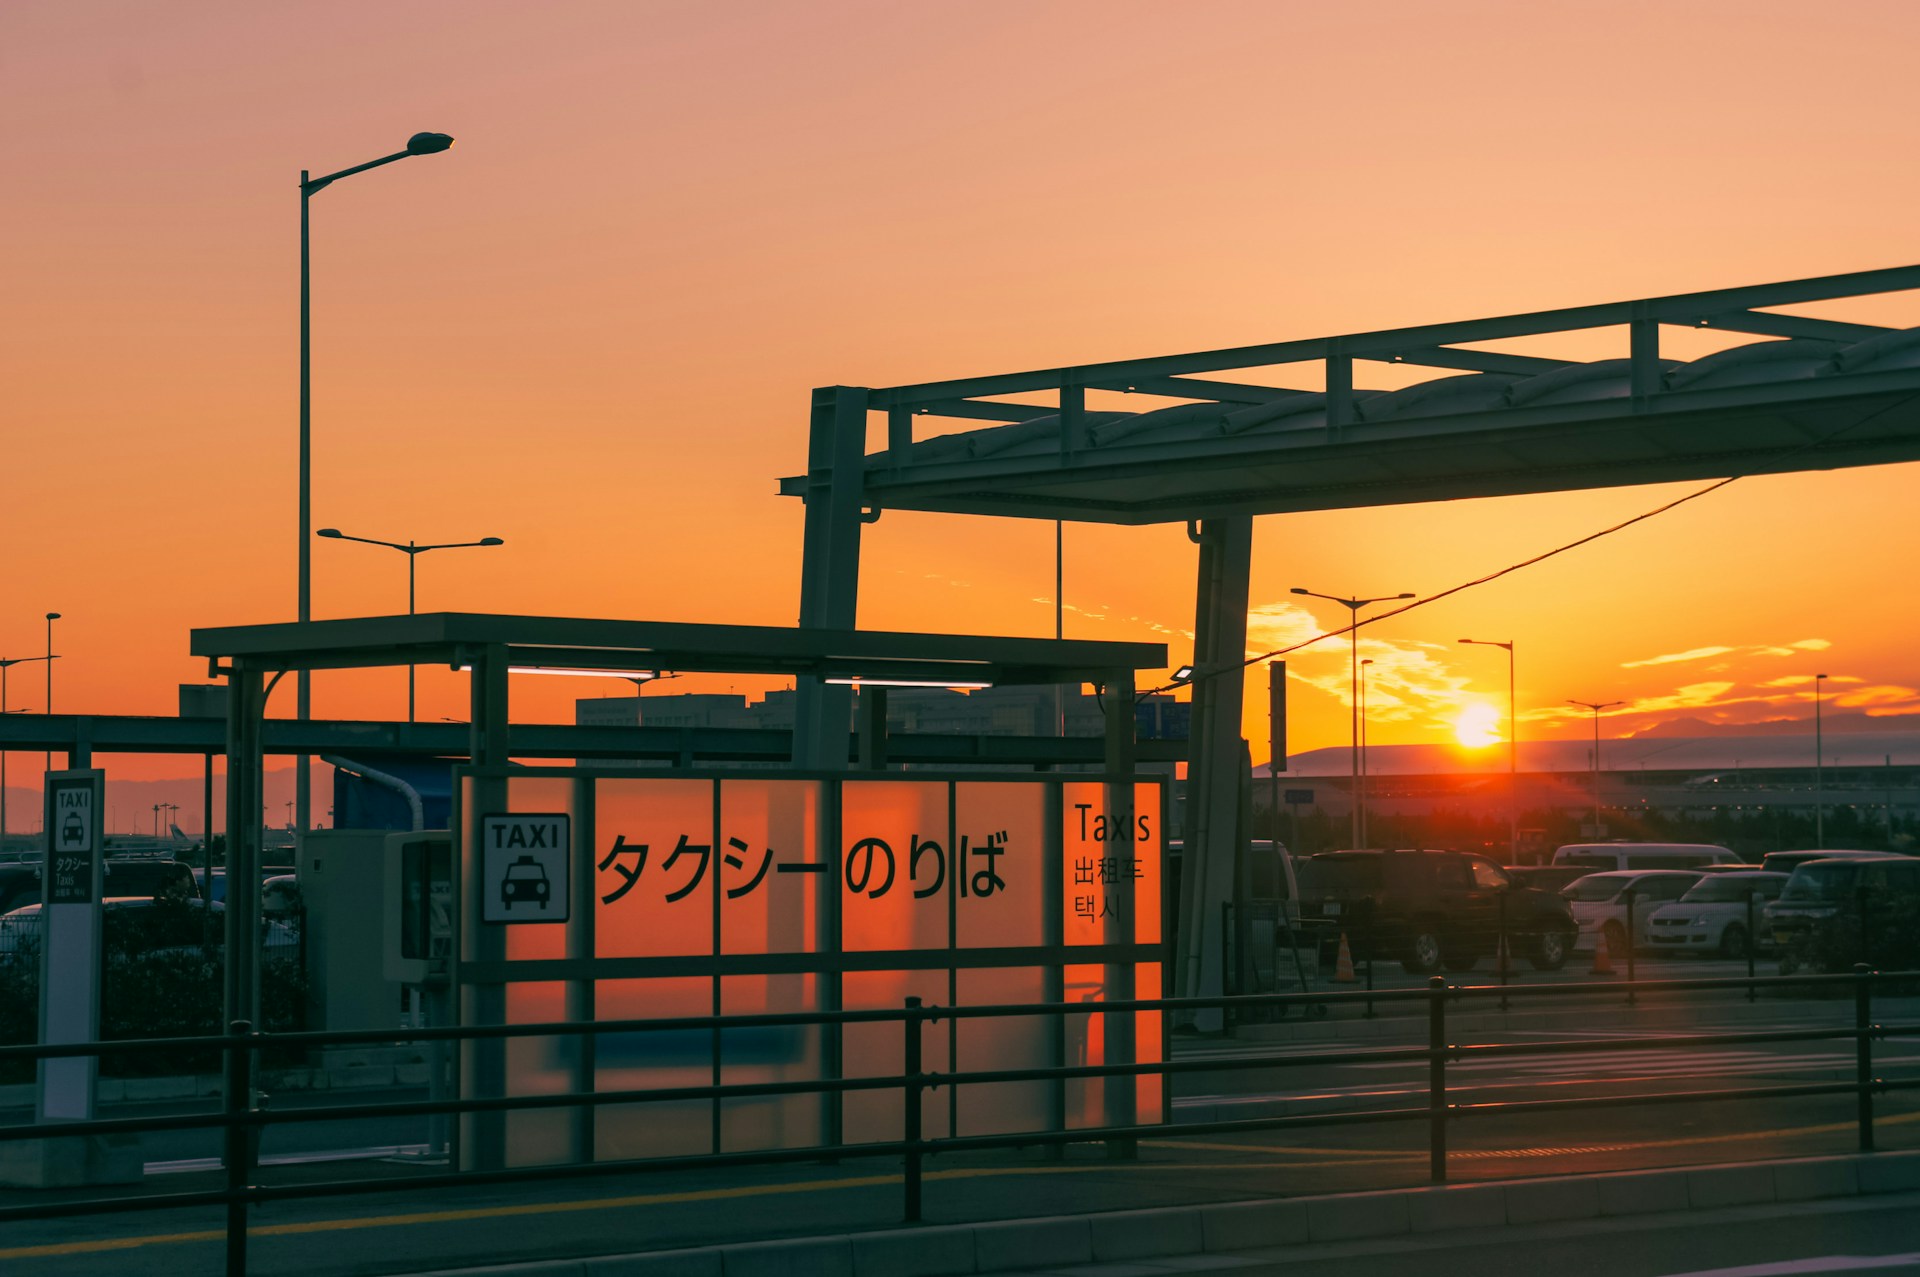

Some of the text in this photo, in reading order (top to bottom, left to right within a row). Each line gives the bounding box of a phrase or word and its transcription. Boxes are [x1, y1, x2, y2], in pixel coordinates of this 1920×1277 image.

[60, 792, 88, 808] TAXI
[1075, 804, 1150, 842] Taxis
[492, 824, 557, 848] TAXI
[56, 857, 89, 872] タクシー
[1075, 856, 1145, 885] 出租车
[56, 873, 74, 886] Taxis
[1075, 894, 1119, 924] 택시
